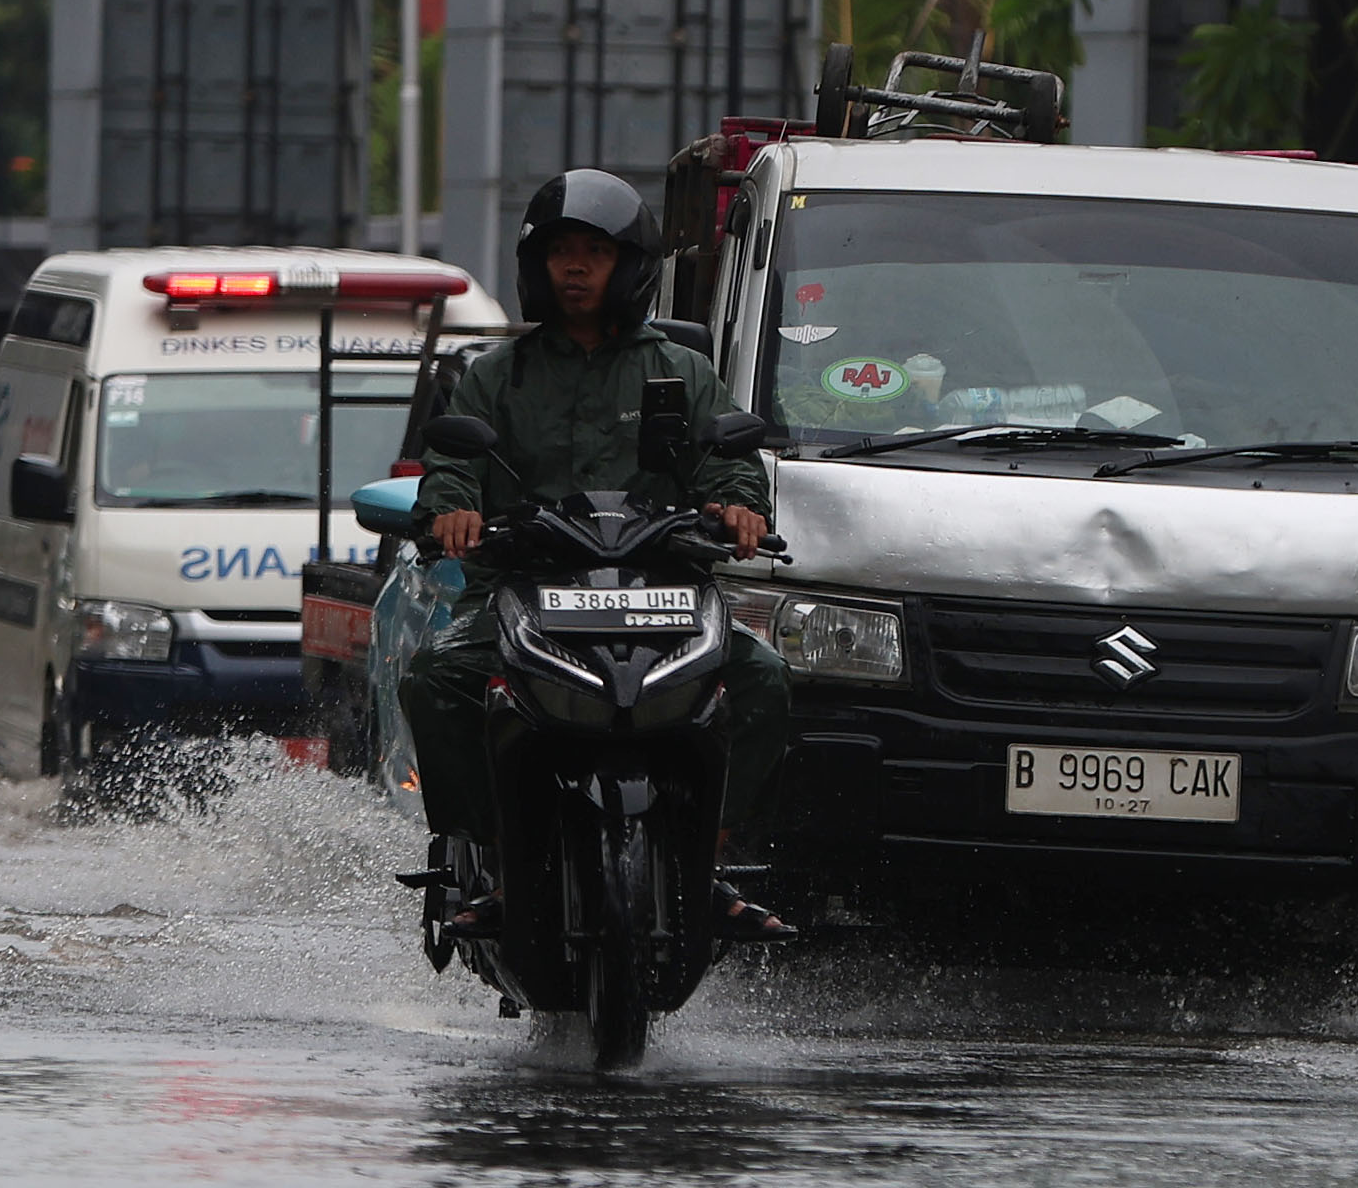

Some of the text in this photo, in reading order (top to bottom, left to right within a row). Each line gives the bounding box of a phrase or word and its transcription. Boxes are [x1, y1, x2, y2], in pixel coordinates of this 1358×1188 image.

[162, 335, 268, 355] DINKES
[842, 364, 891, 389] RAJ
[550, 592, 690, 609] B 3868 UWA
[1015, 750, 1232, 798] B 9969 CAK
